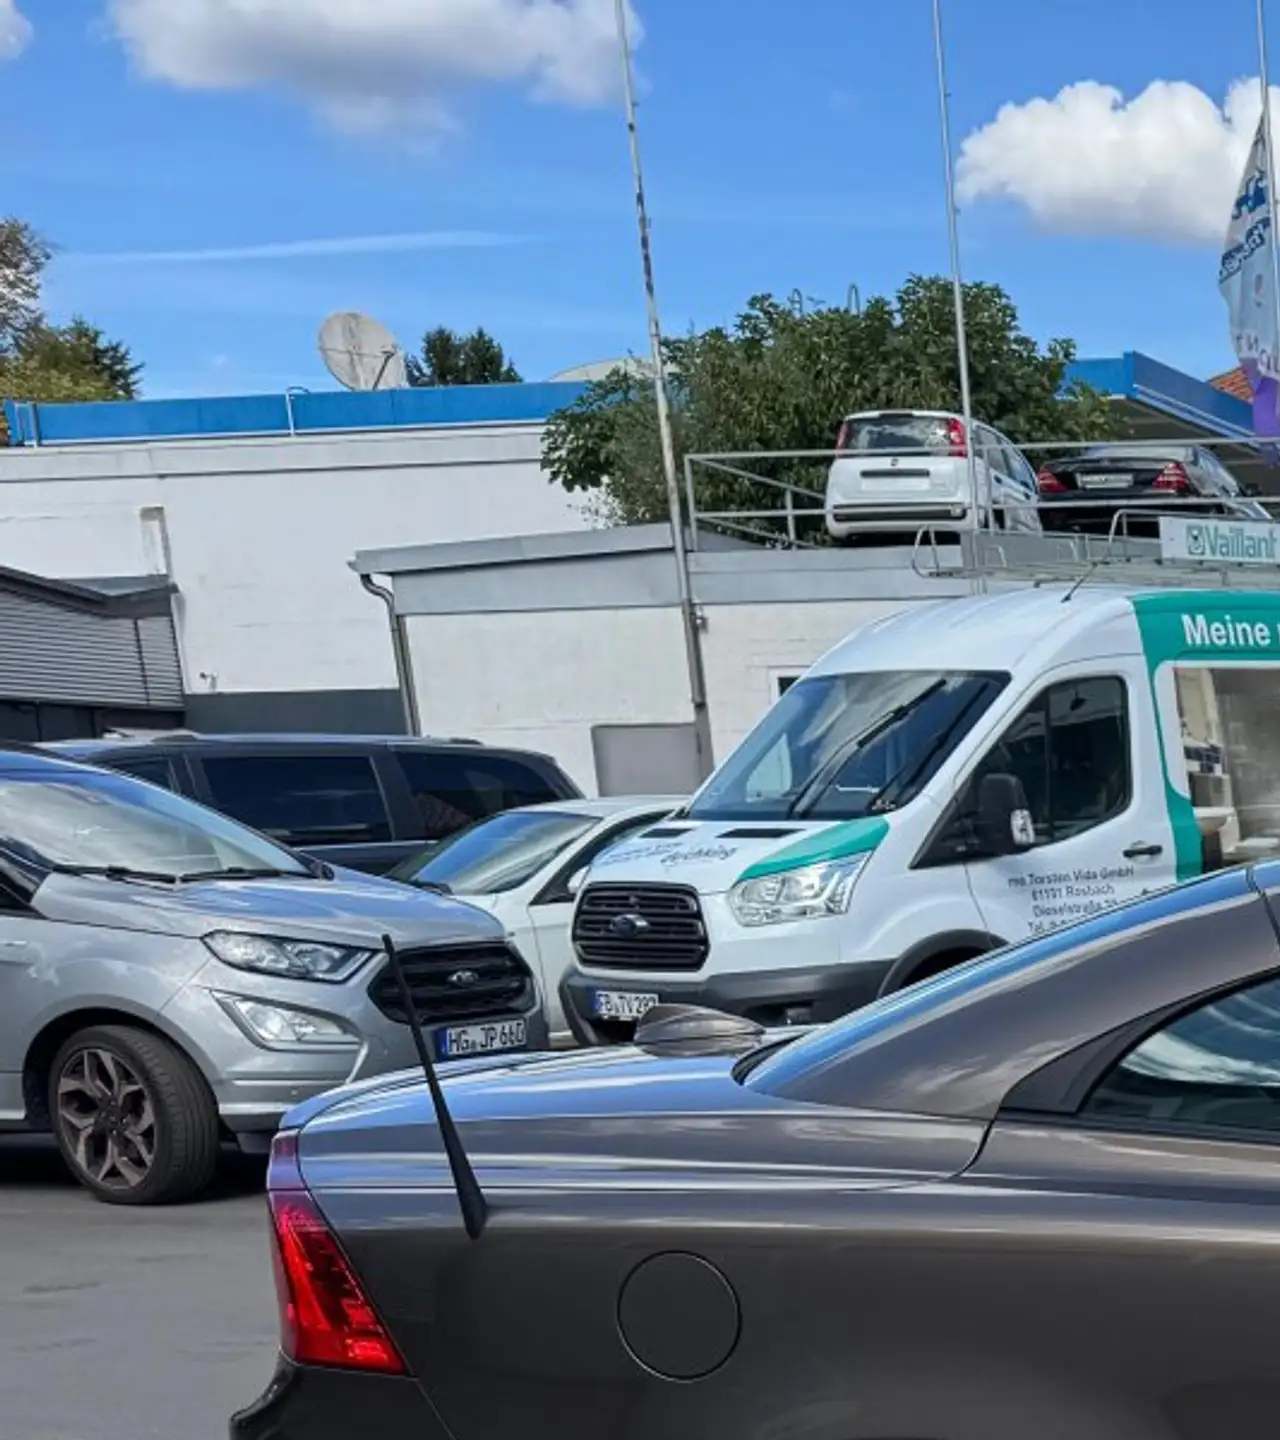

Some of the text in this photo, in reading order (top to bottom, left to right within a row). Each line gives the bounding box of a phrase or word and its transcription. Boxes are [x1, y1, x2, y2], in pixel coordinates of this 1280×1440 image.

[1200, 526, 1278, 559] Vaillant
[1182, 613, 1271, 646] Meine
[449, 1020, 525, 1053] HG JP 660
